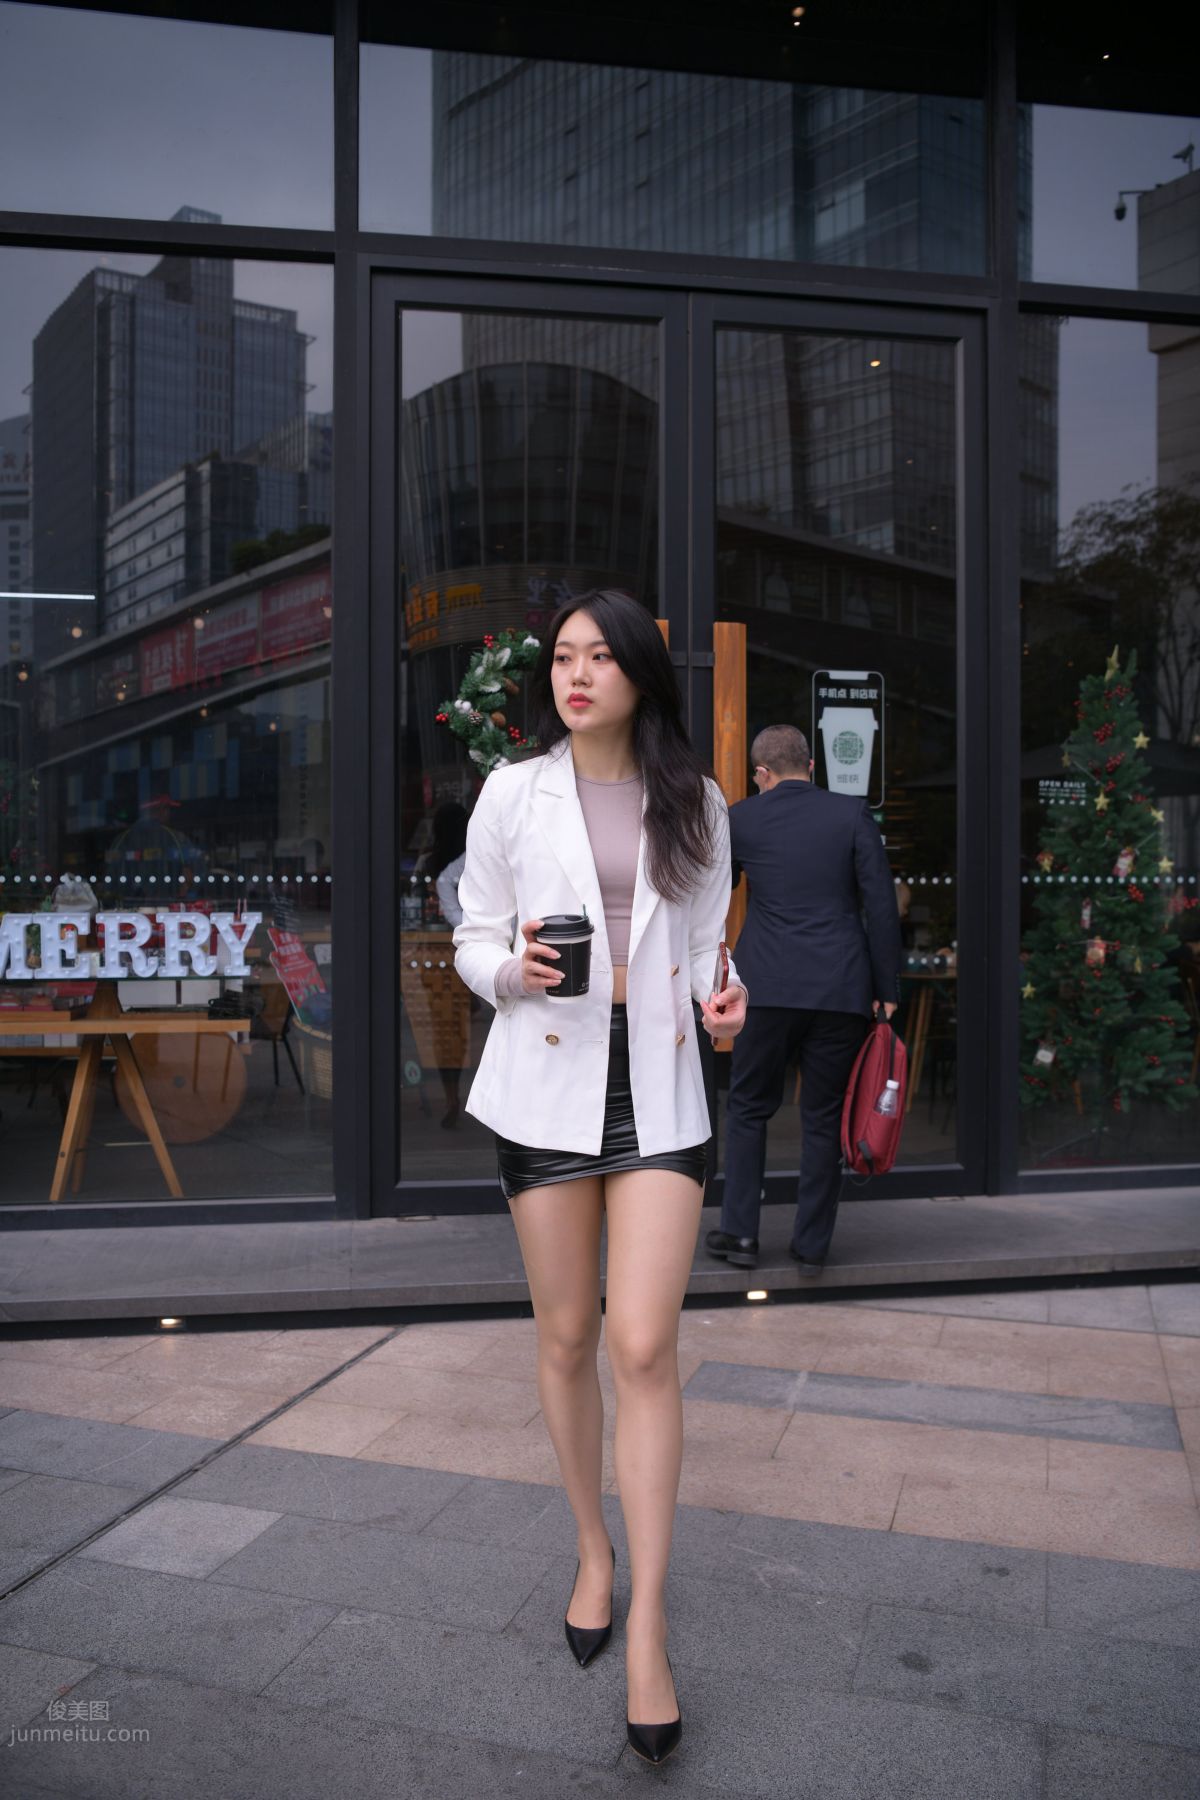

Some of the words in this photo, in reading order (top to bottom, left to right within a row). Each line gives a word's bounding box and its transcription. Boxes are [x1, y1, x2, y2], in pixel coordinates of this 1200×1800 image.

[818, 687, 847, 699] 手机点
[849, 687, 878, 700] 到店取
[1039, 780, 1061, 788] OPEN
[1063, 781, 1086, 789] DAILY
